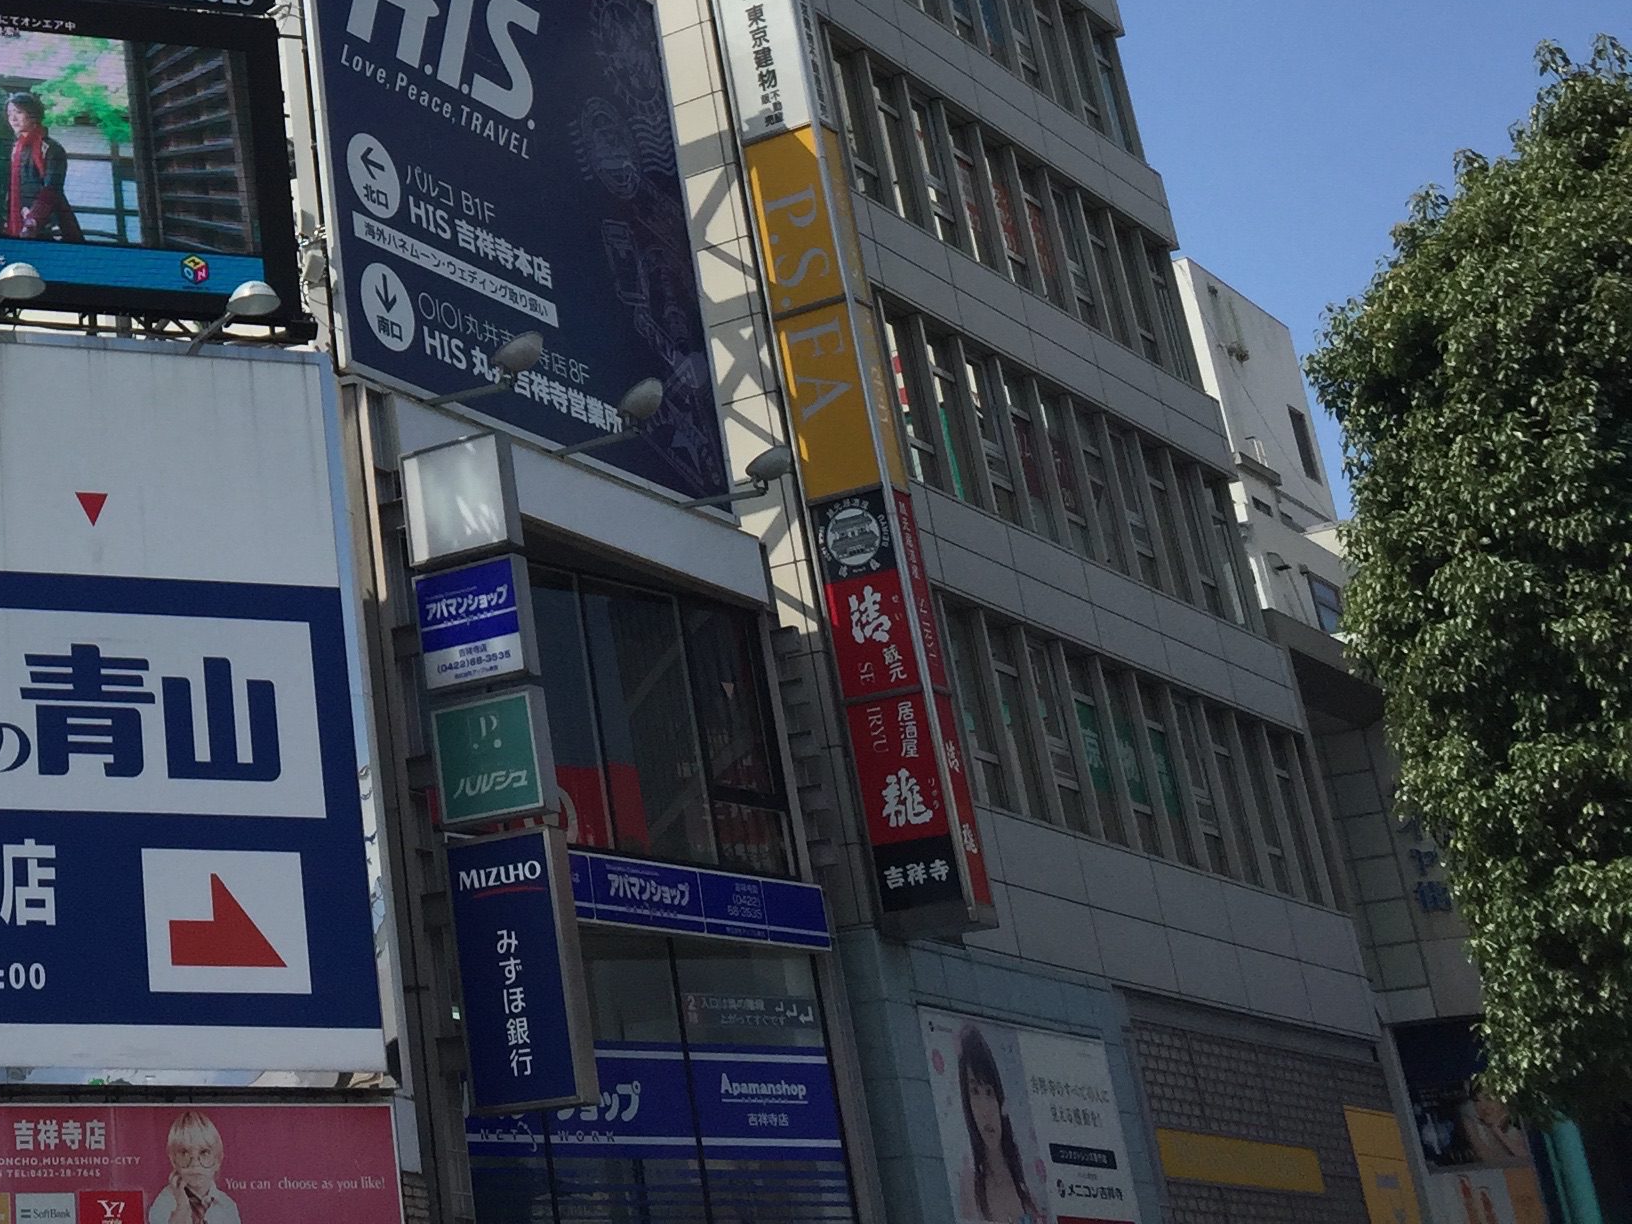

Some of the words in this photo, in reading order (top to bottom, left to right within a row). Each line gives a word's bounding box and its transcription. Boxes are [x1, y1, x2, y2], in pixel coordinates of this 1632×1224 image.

[745, 3, 777, 91] 東京建物
[460, 102, 530, 160] TRAVEL
[363, 182, 389, 210] 北口
[405, 164, 454, 207] パルコ
[461, 190, 496, 223] B1F
[408, 195, 451, 240] HIS
[455, 218, 553, 290] 吉祥寺本店
[377, 315, 403, 342] 南口
[423, 326, 467, 370] HIS
[472, 346, 623, 434] 丸吉祥寺営業所
[425, 583, 508, 622] アパマンショップ
[849, 584, 892, 644] 清
[880, 767, 933, 828] 龍
[458, 860, 542, 891] MIZUHO
[607, 873, 690, 906] アパマンショップ
[883, 858, 950, 891] 吉祥寺
[496, 929, 533, 1077] みずほ銀行
[721, 1072, 807, 1100] Apamanshop
[13, 1120, 106, 1151] 吉祥寺店
[748, 1112, 789, 1127] 吉祥寺店
[225, 1177, 246, 1190] You
[250, 1180, 270, 1190] can
[278, 1176, 318, 1190] choose
[321, 1180, 334, 1190] as
[337, 1180, 358, 1193] you
[360, 1175, 386, 1190] like!
[33, 1208, 71, 1219] SoftBank
